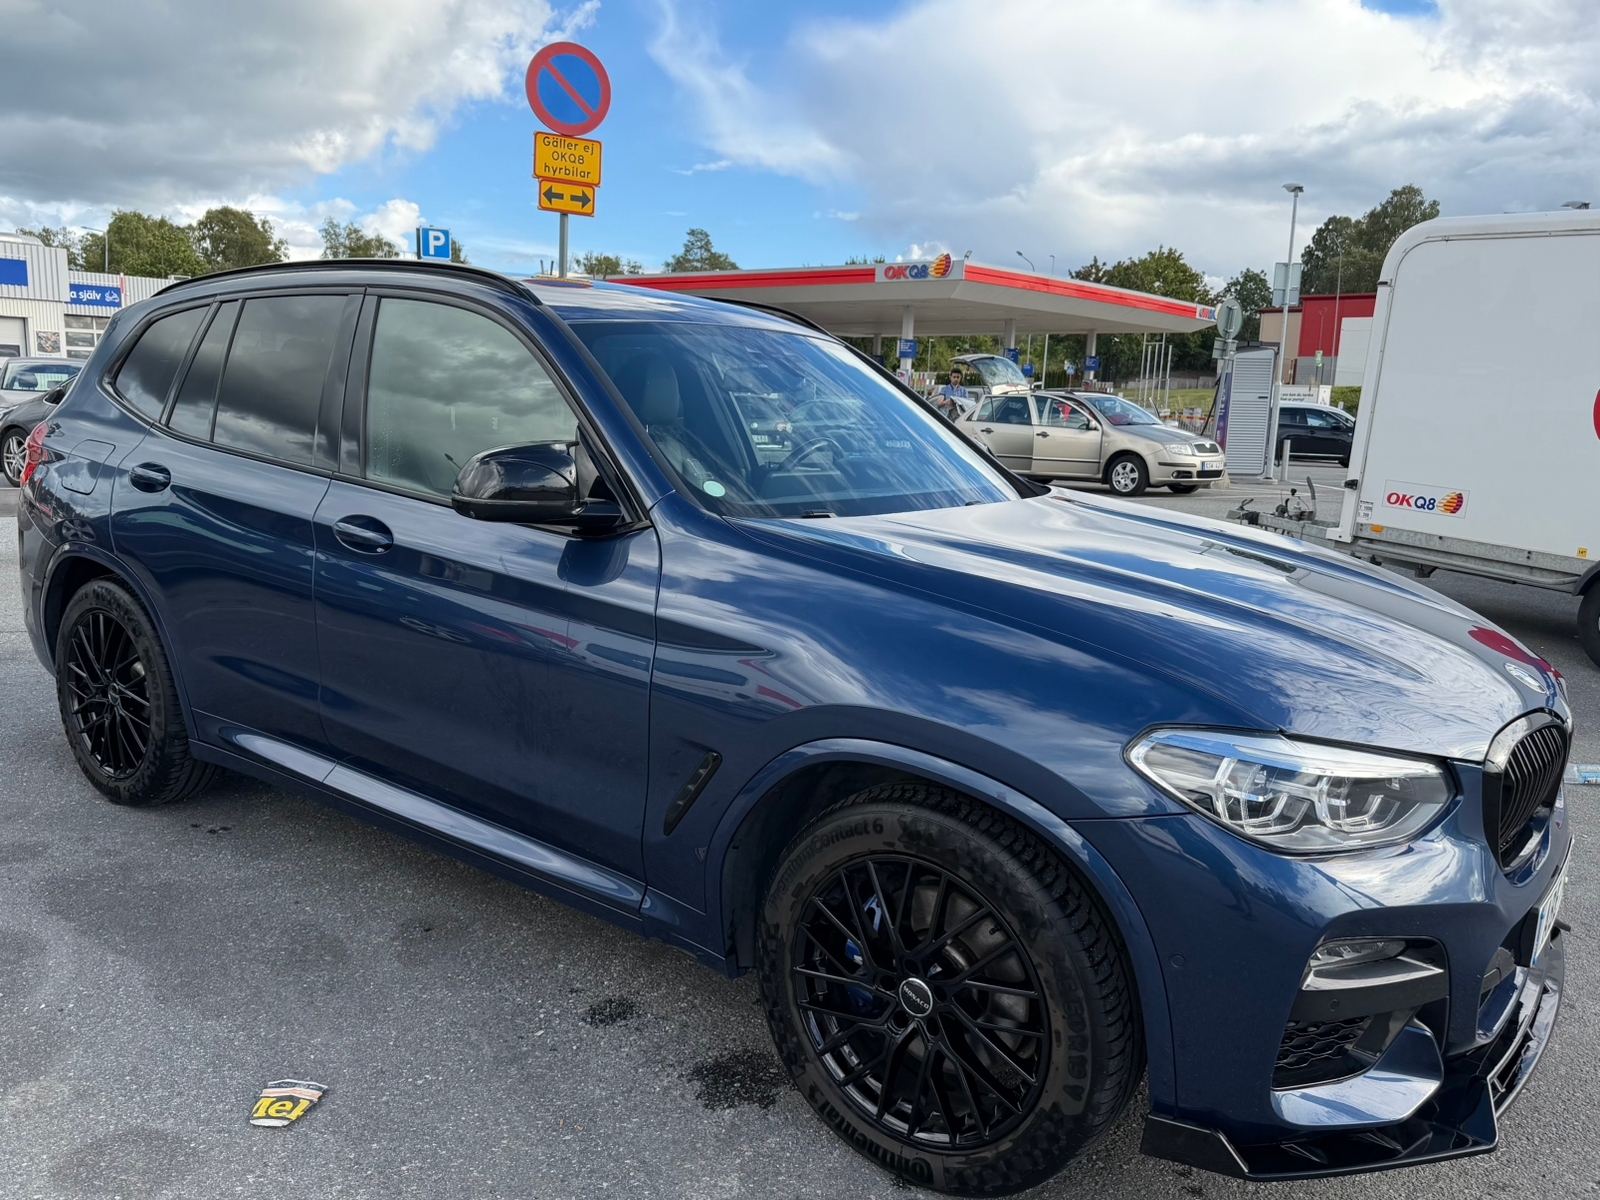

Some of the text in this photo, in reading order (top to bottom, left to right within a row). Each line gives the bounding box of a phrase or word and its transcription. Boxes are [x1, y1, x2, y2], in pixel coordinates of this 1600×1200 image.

[543, 136, 594, 156] Gäller ej
[552, 151, 585, 165] OKQ8
[544, 162, 591, 179] hyrbilar
[429, 231, 445, 255] P
[884, 264, 928, 280] OKQ8
[79, 289, 101, 301] själv
[1386, 492, 1437, 511] OKQ8
[903, 985, 930, 1009] MONACO
